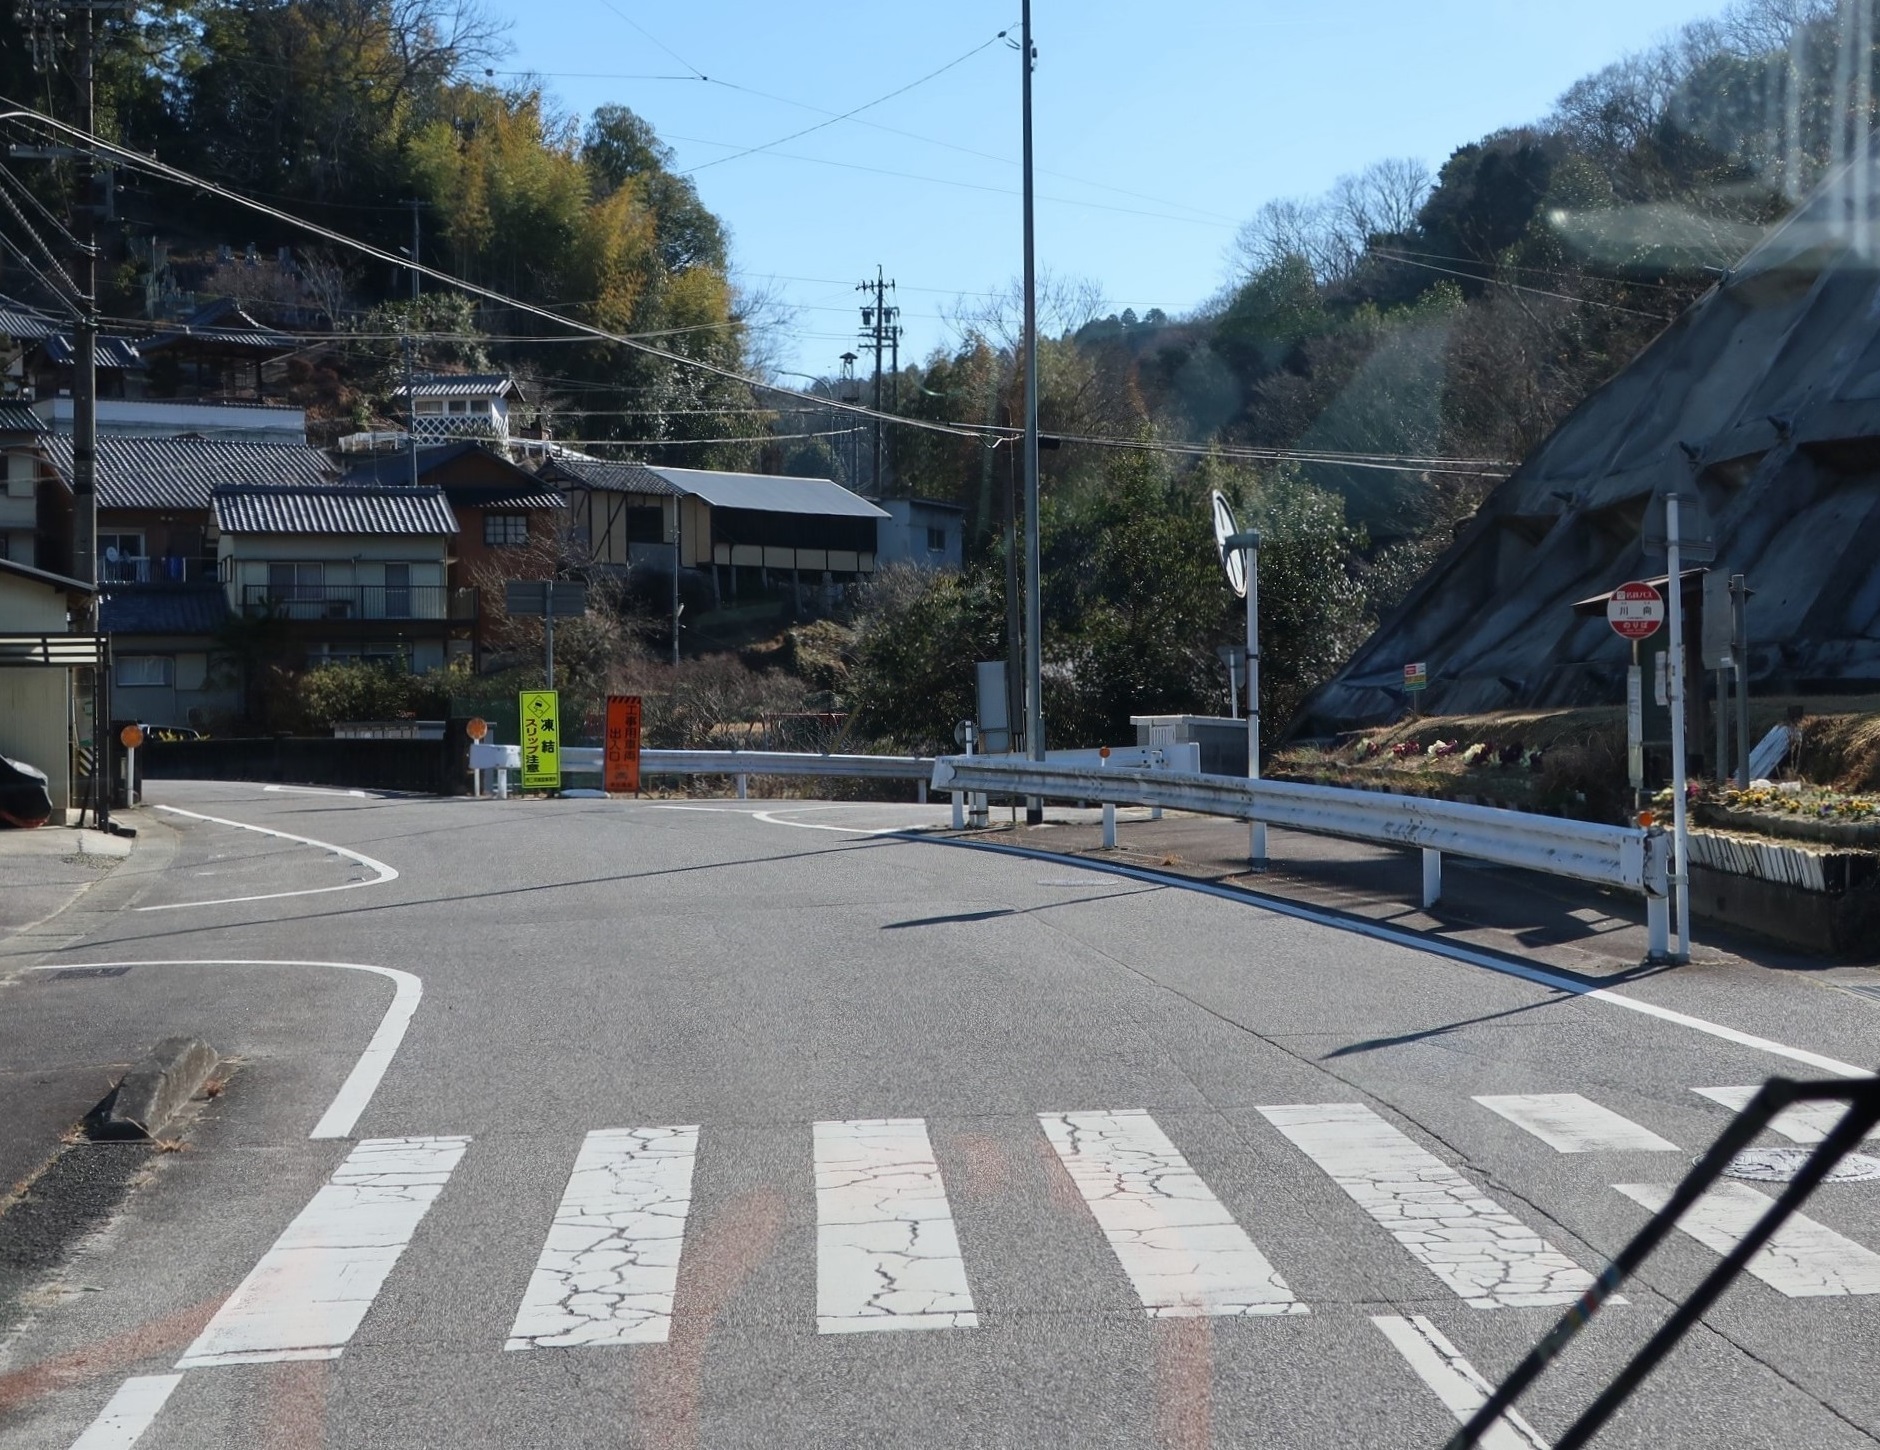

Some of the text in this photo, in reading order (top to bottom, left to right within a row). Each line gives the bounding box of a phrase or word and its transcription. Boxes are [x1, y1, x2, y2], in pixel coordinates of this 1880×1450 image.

[525, 718, 540, 773] スリップ注意
[540, 718, 555, 754] 凍結
[609, 729, 620, 762] 出入口
[624, 705, 637, 761] 工事用車両
